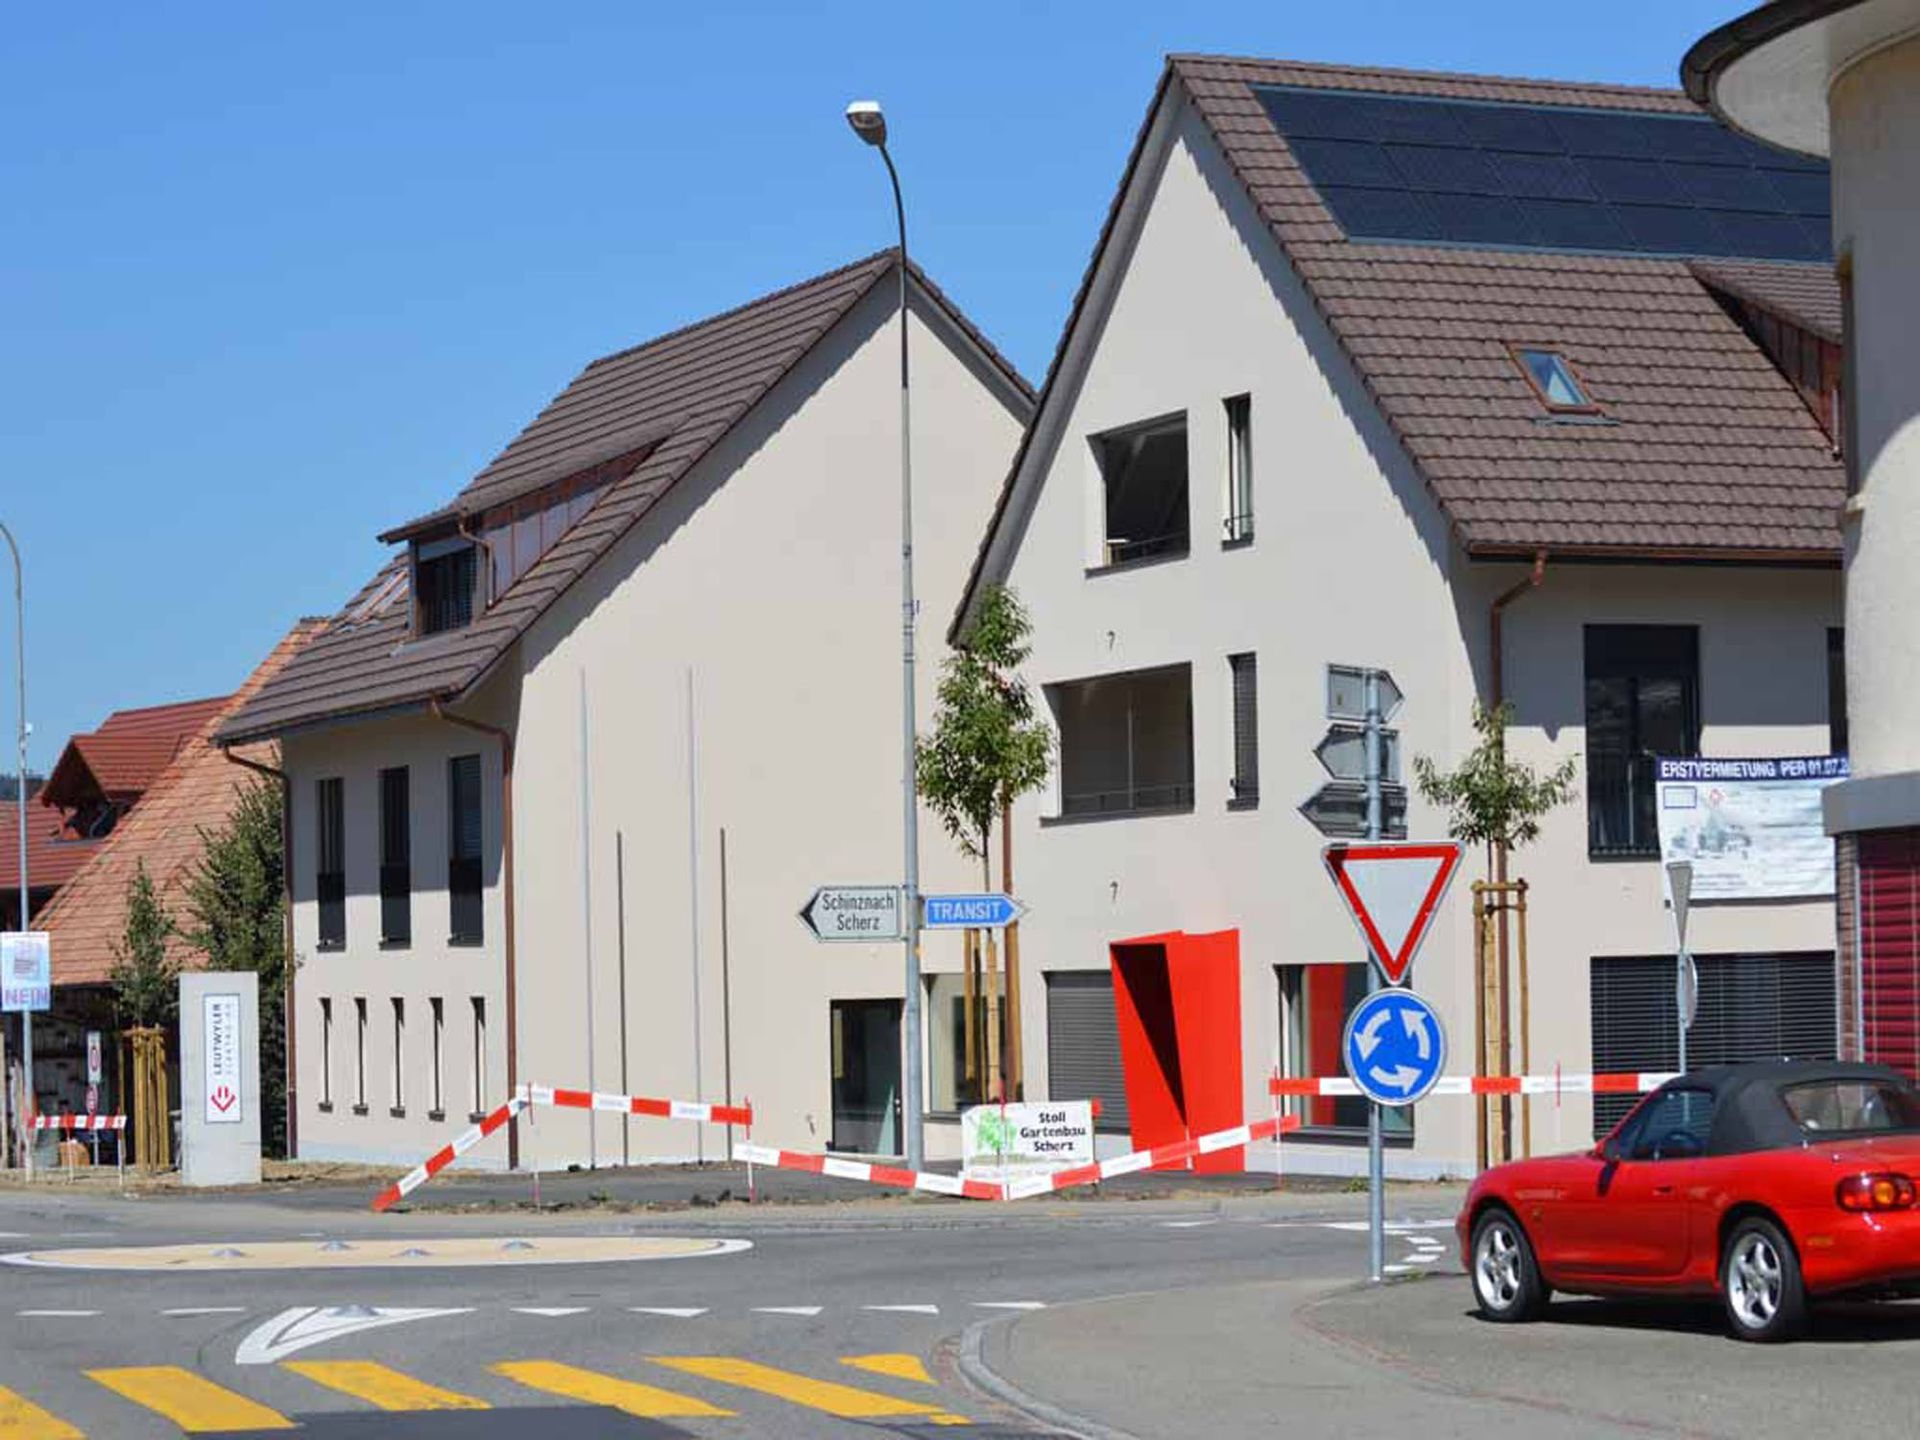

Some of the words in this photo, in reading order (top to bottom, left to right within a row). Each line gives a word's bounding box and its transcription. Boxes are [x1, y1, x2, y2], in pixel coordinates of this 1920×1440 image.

[1661, 761, 1776, 777] ERSTVERMIETUNG
[1780, 759, 1806, 776] PER
[822, 892, 894, 910] Schinznach
[836, 914, 880, 930] Scherz
[5, 988, 49, 1006] NEIN
[213, 1004, 222, 1075] LEUTWYLER
[1038, 1111, 1066, 1123] Stoll
[1020, 1126, 1086, 1138] Gartenbau
[1033, 1140, 1074, 1152] Scherz
